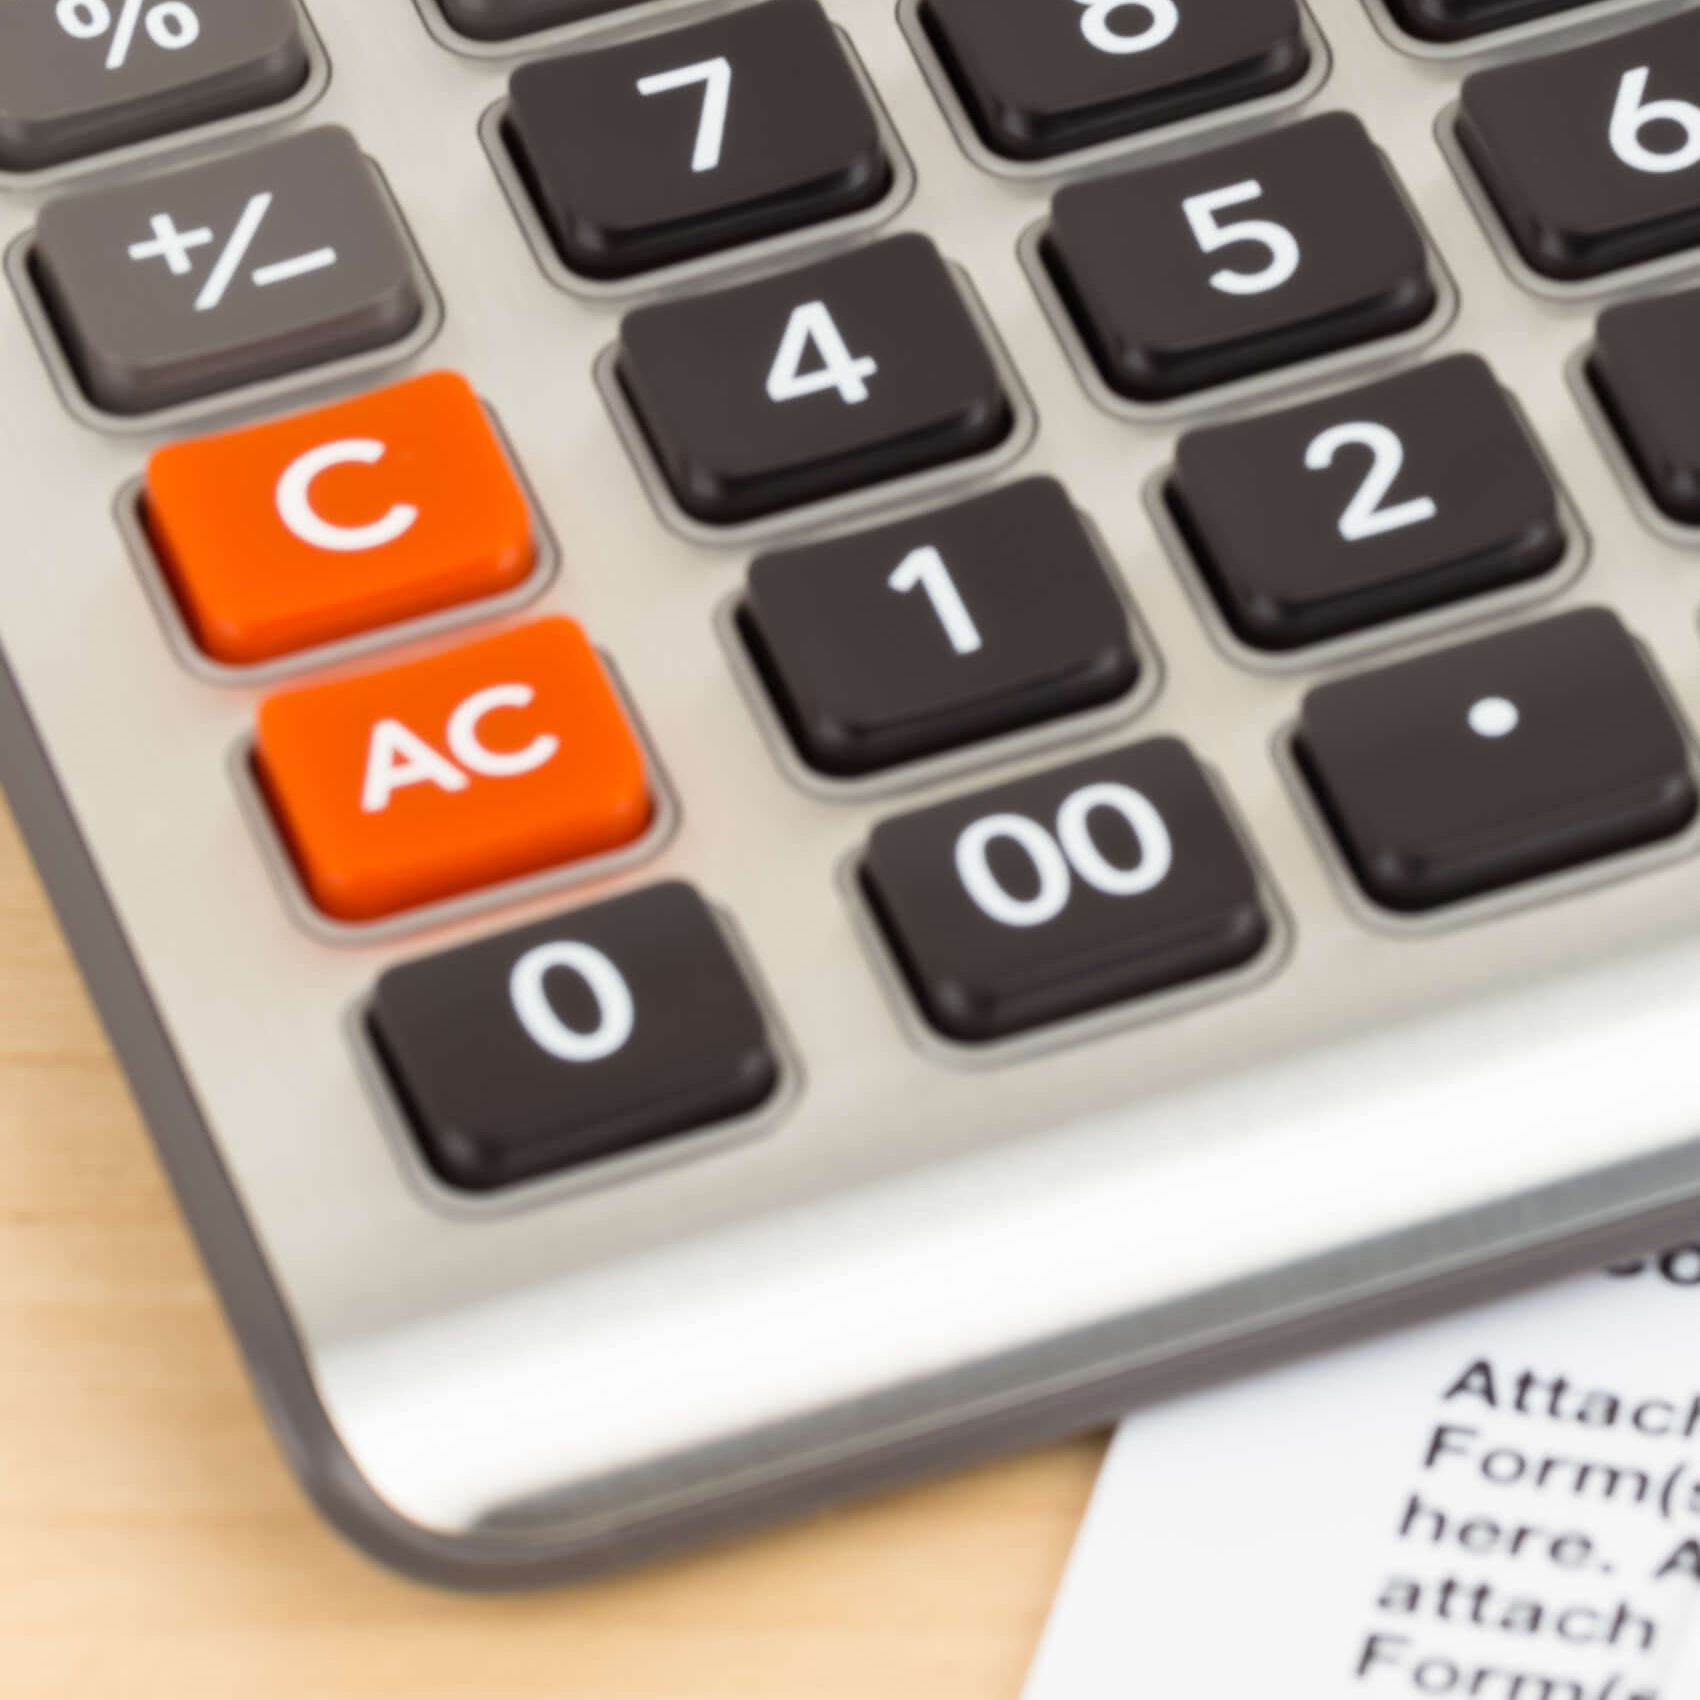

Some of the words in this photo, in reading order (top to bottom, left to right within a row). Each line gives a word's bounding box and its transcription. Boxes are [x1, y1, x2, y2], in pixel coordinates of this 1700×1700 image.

[638, 58, 730, 170] 7
[1184, 181, 1298, 293] 5
[768, 303, 875, 402] 4
[278, 440, 414, 549] C
[1307, 424, 1434, 538] 2
[892, 548, 979, 651] 1
[364, 686, 555, 809] AC
[957, 785, 1170, 924] 00
[512, 943, 631, 1058] 0
[1398, 1494, 1614, 1573] here.
